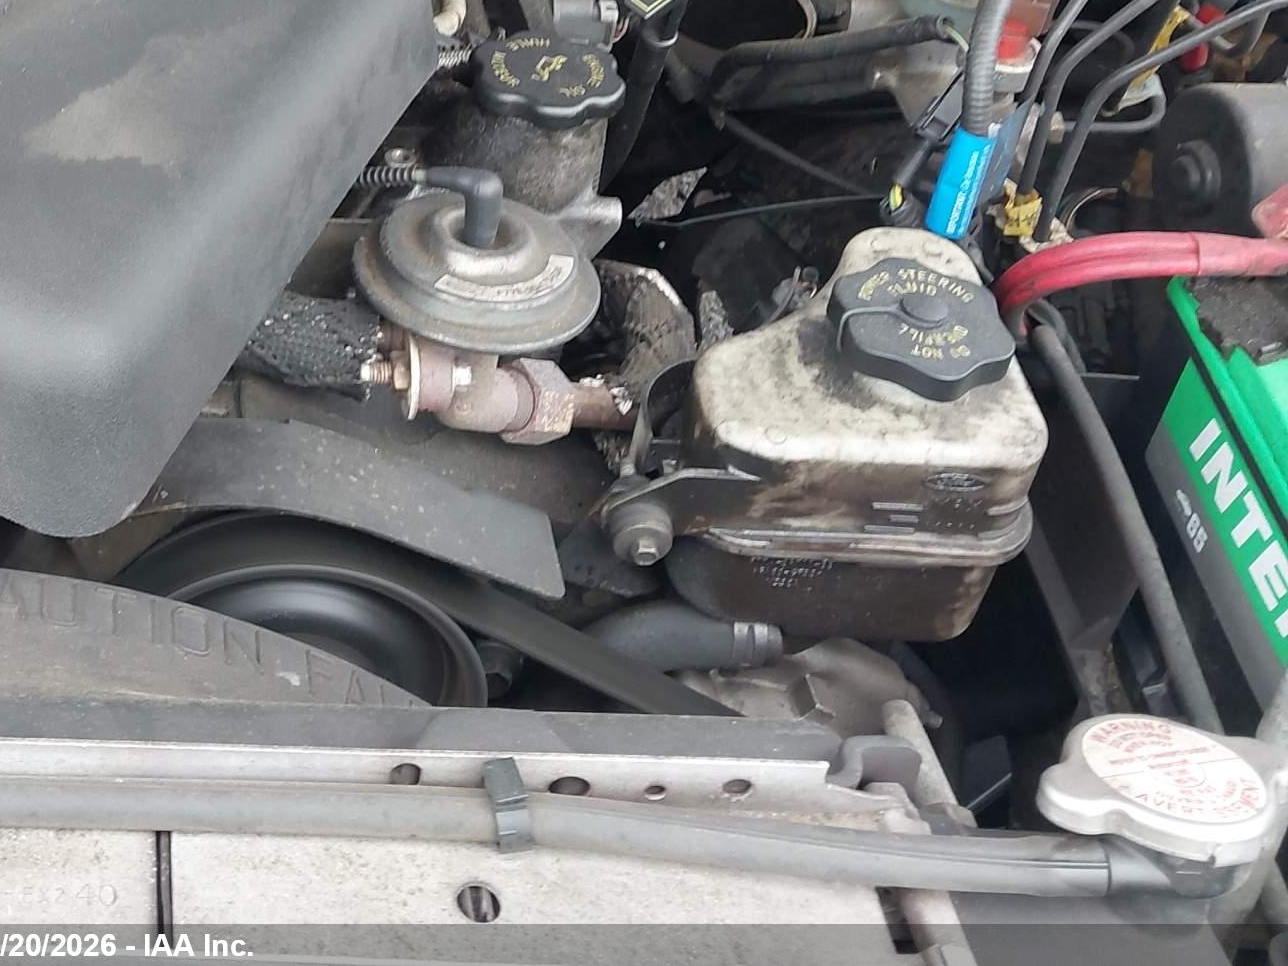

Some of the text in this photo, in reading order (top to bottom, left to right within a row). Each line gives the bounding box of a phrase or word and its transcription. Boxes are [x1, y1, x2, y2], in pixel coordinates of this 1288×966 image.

[857, 268, 975, 304] POWER STEERING
[886, 281, 938, 298] FLUID
[898, 322, 969, 346] OVERFILL
[910, 344, 945, 362] NOT
[1189, 417, 1288, 639] INTE
[1090, 720, 1173, 743] WARNING
